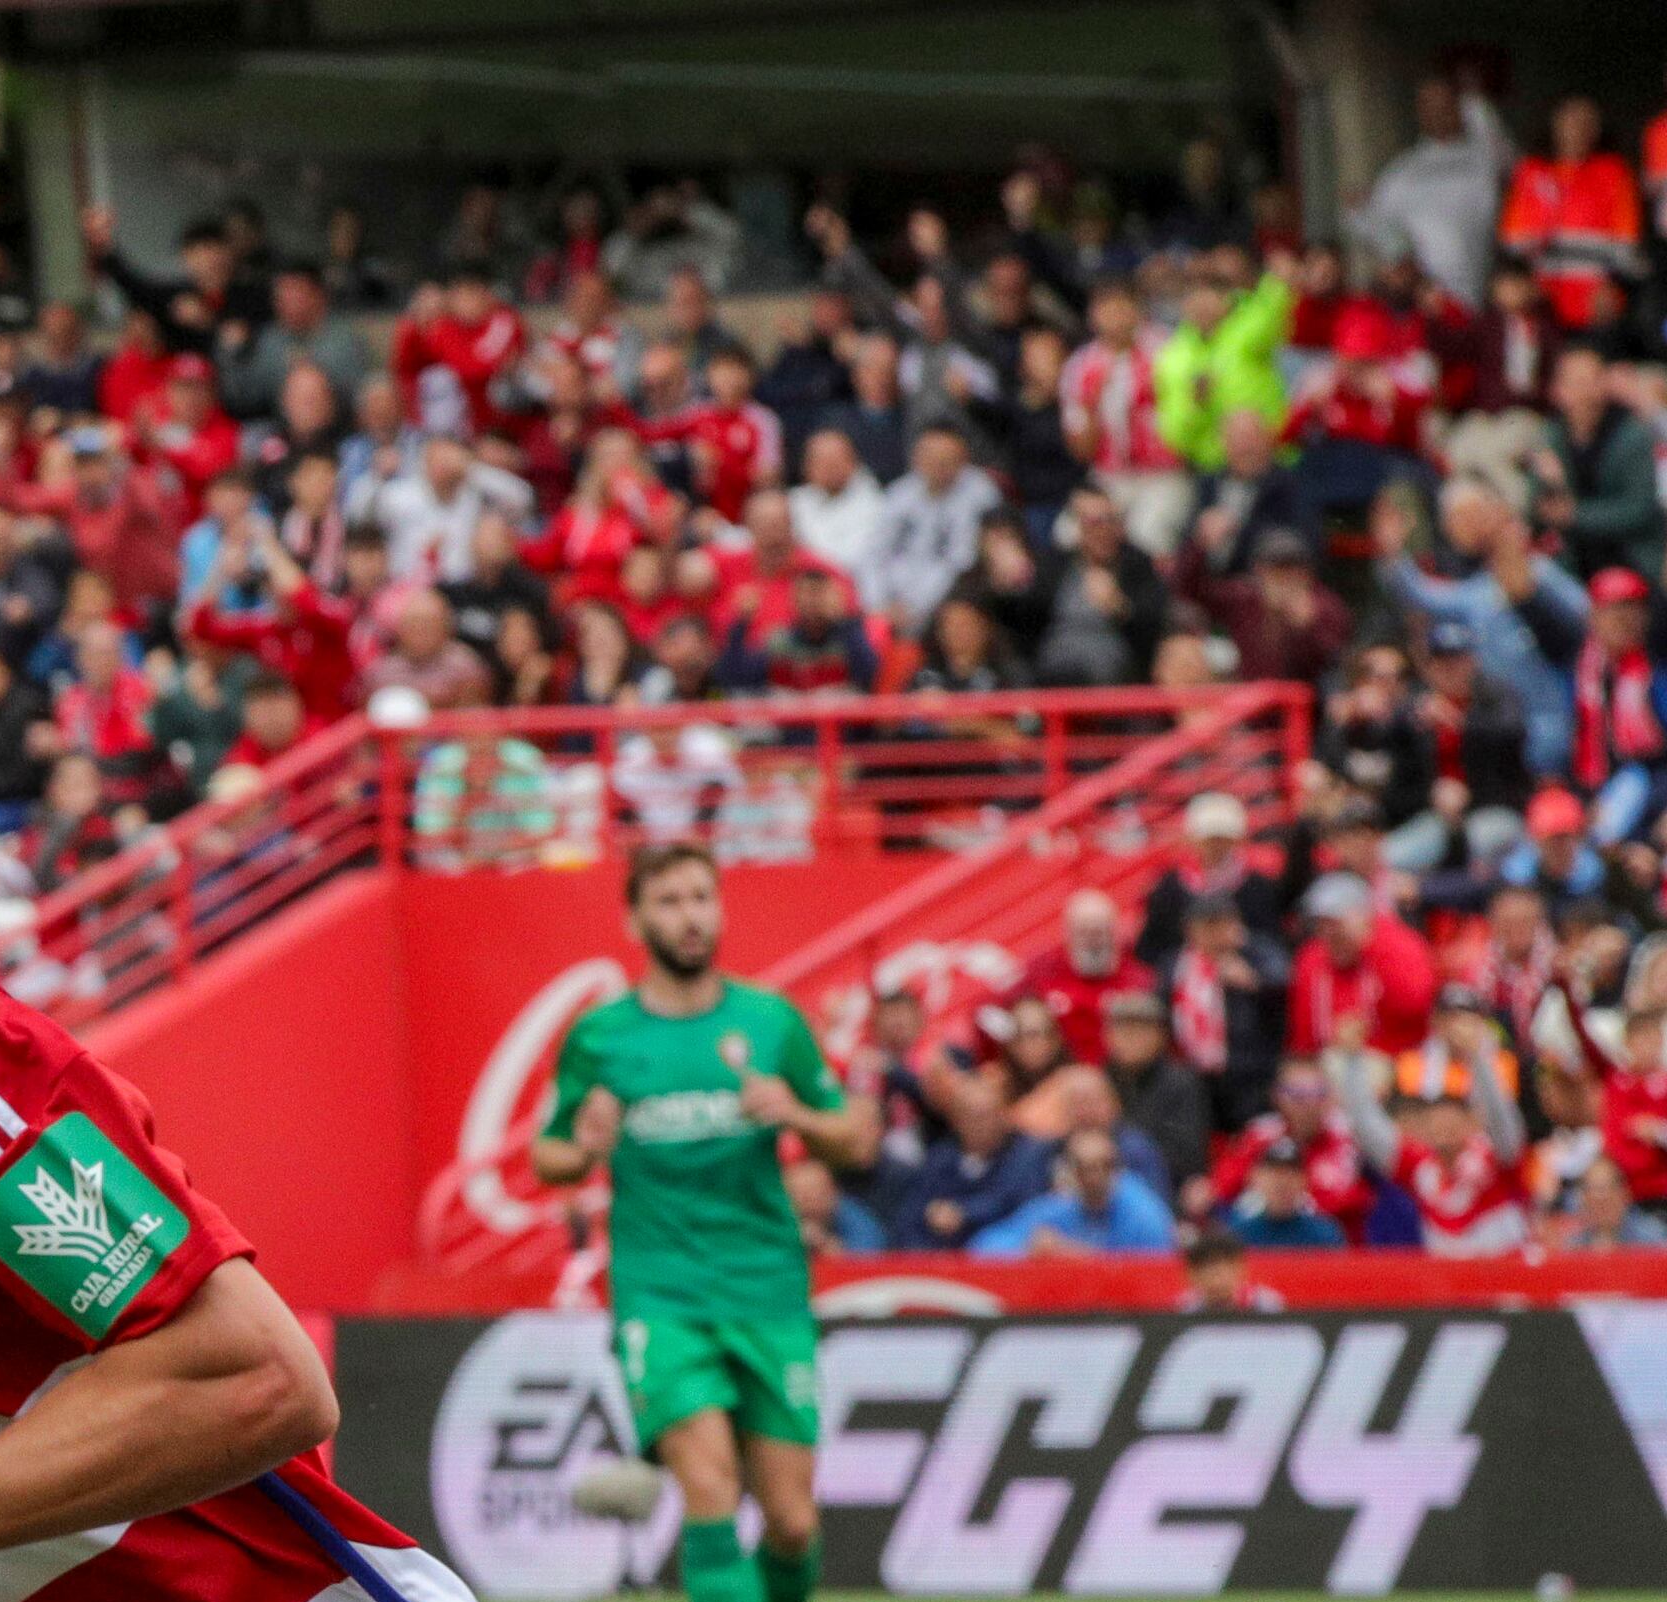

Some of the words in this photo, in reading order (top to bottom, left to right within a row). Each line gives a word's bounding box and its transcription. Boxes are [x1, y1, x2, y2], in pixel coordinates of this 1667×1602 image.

[70, 1271, 111, 1314] CAJA
[101, 1212, 164, 1273] RURAL
[97, 1245, 154, 1308] GRANADA
[490, 1379, 625, 1470] EA
